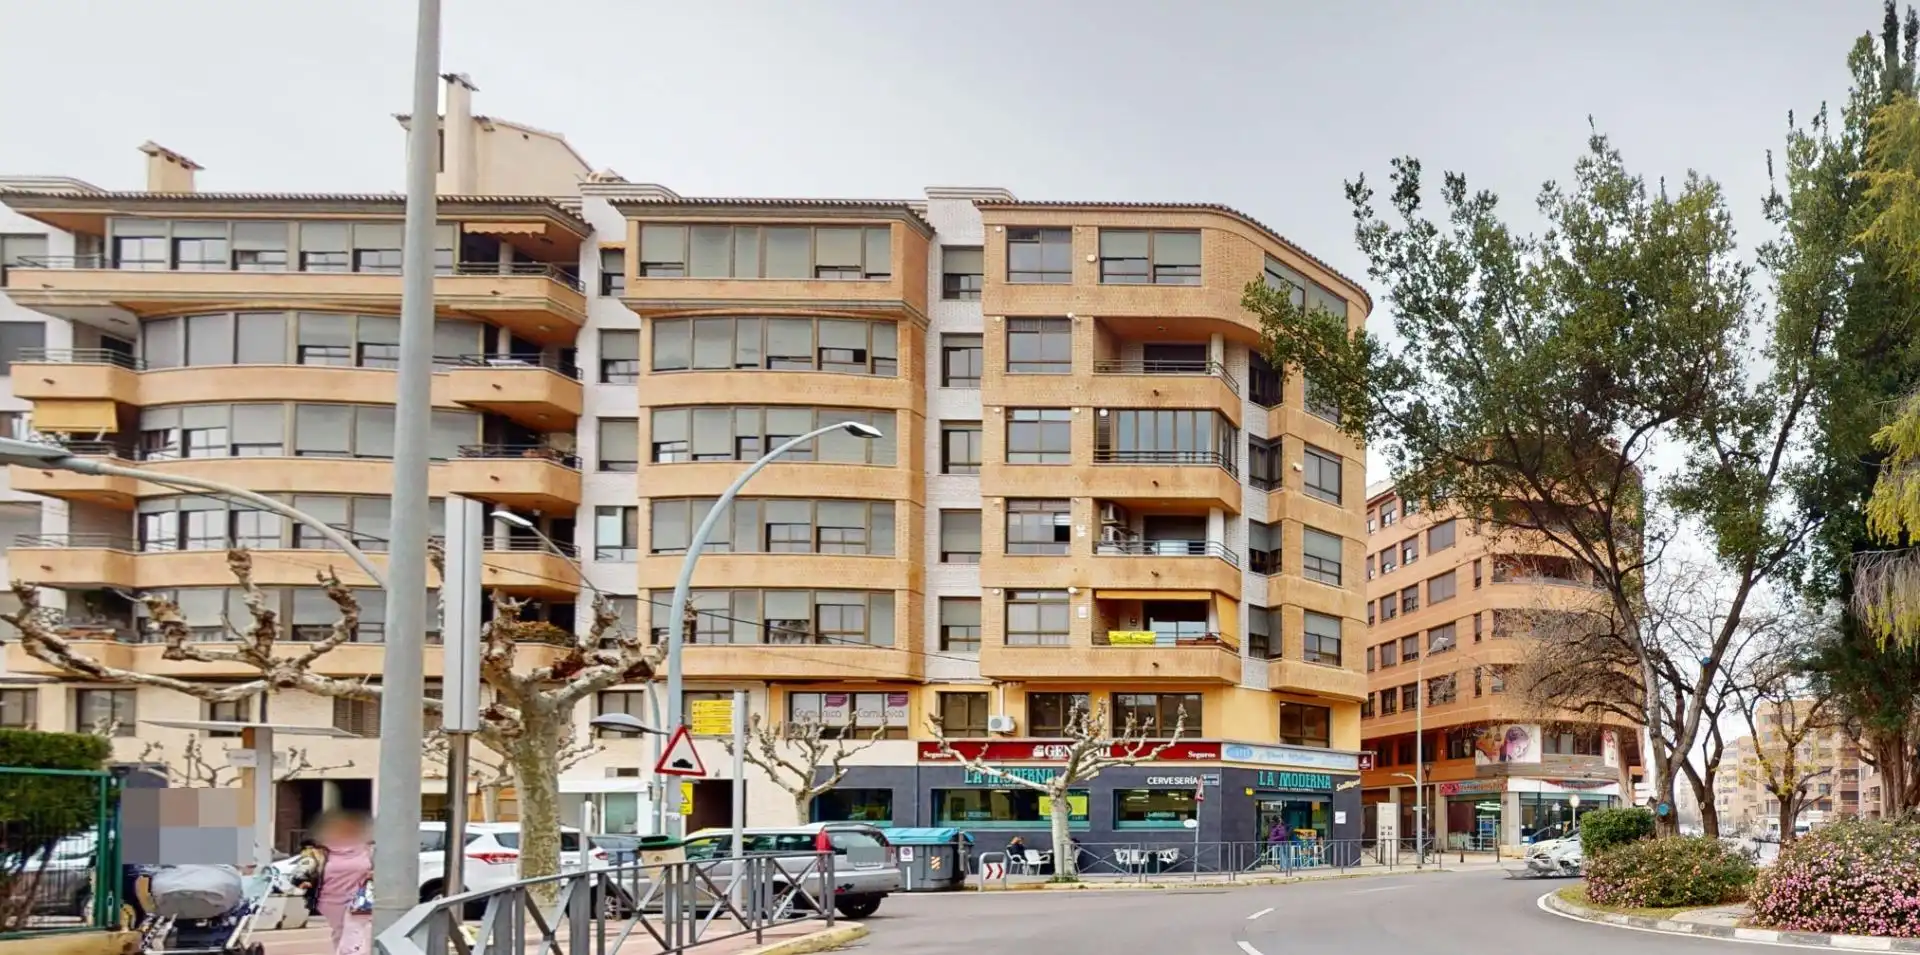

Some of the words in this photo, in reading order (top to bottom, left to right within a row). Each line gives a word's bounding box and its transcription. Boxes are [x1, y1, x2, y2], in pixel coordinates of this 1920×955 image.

[794, 707, 842, 718] Comnica
[857, 707, 905, 718] Comnica
[1044, 744, 1111, 758] GENLI
[1187, 750, 1216, 759] Seguros
[1258, 771, 1274, 786] LA
[1279, 772, 1332, 789] MODERNA
